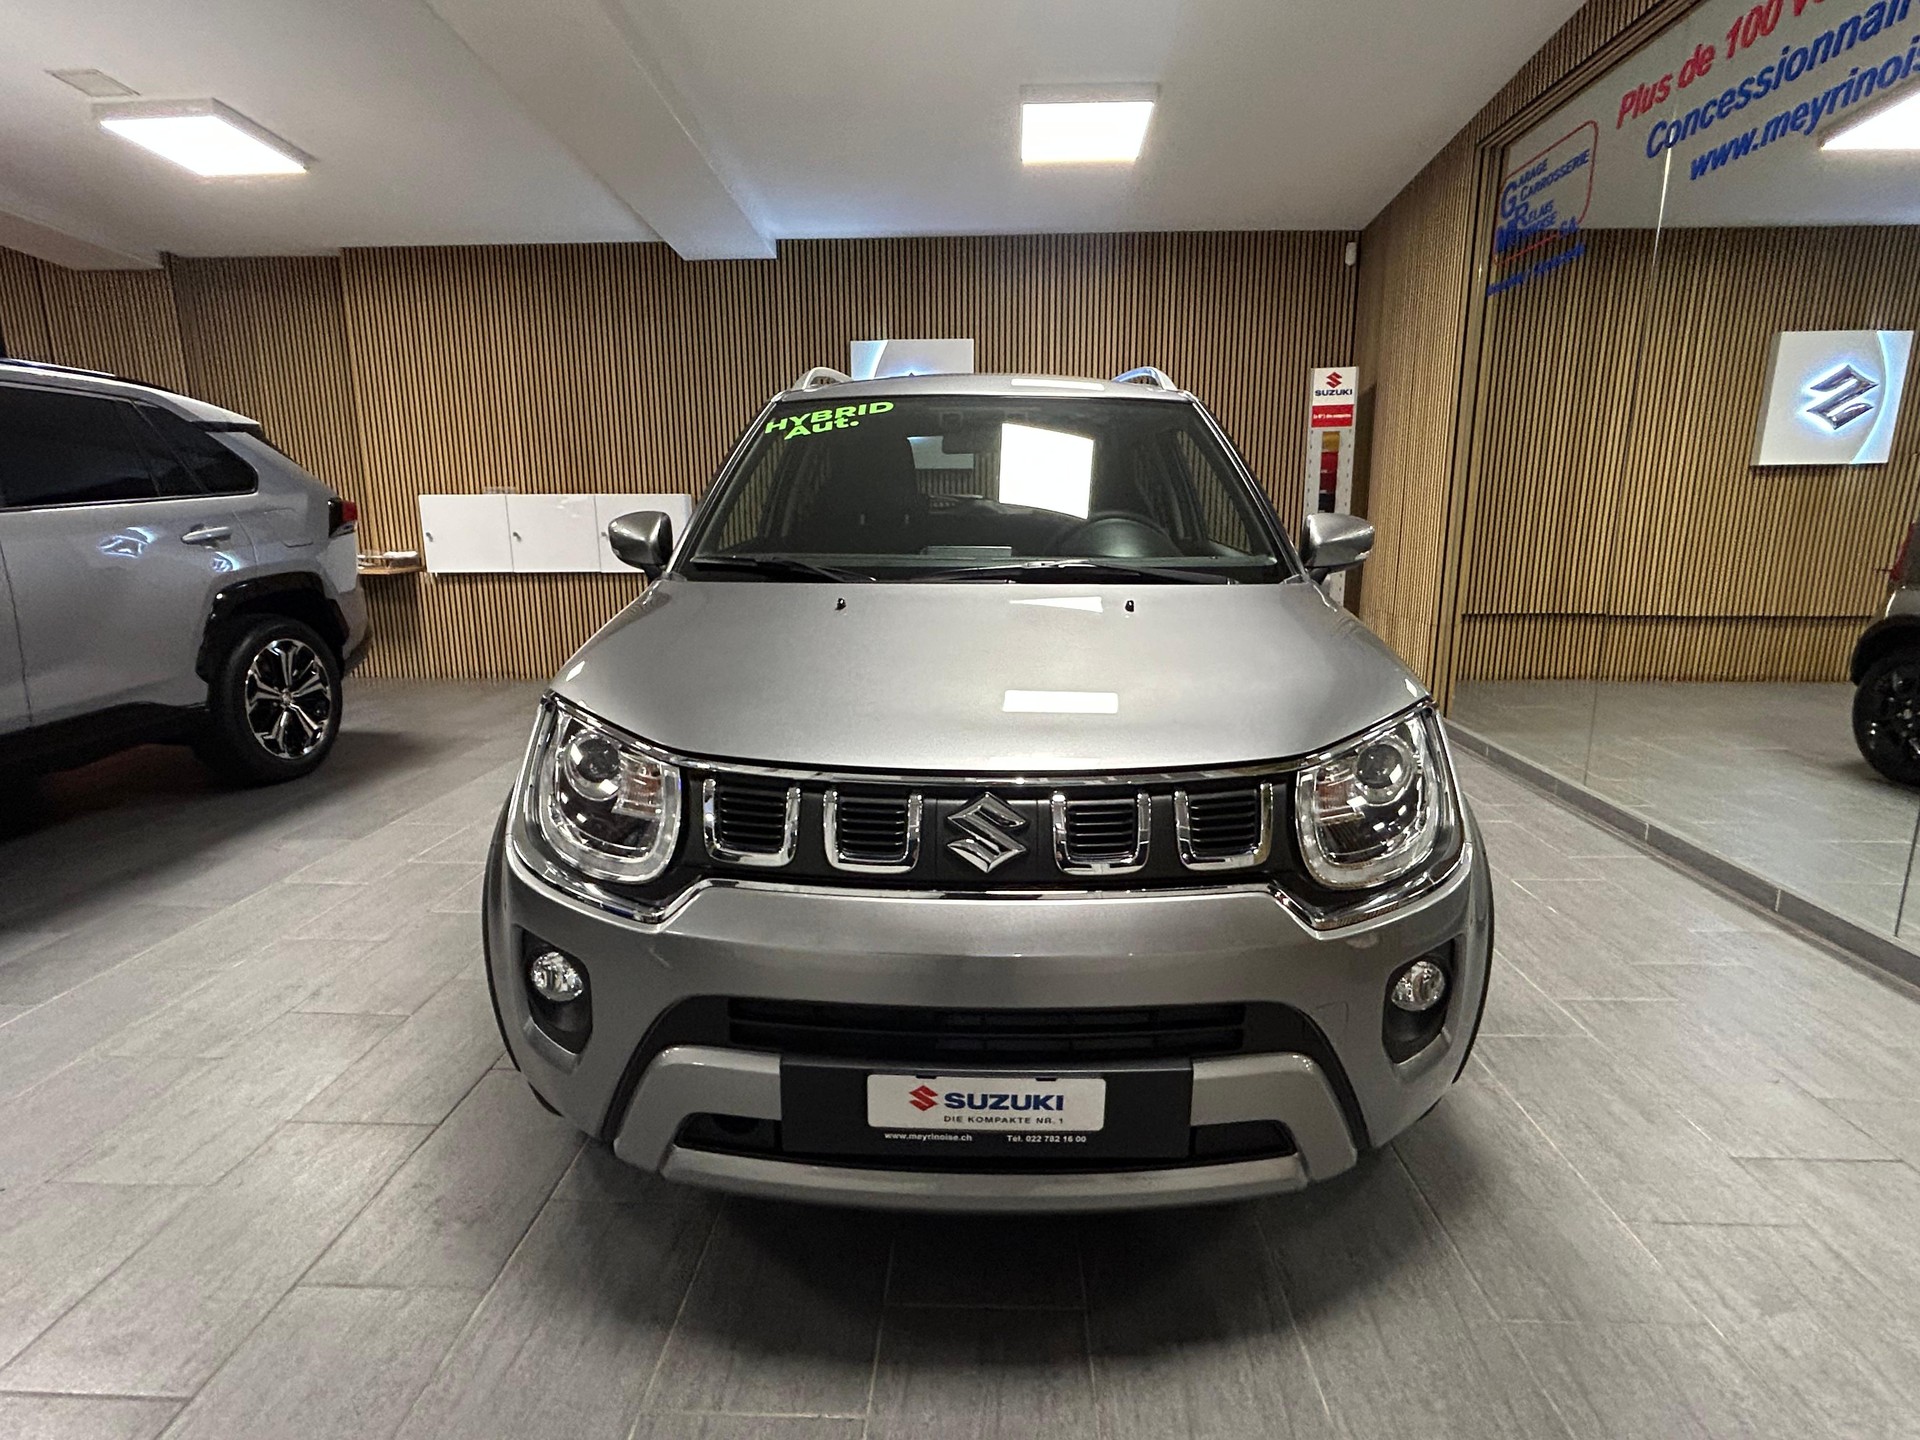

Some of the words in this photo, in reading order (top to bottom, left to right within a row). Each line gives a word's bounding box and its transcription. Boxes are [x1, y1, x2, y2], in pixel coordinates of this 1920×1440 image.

[1616, 73, 1673, 130] Plus
[1678, 43, 1716, 89] de
[1726, 0, 1784, 60] 100
[1314, 388, 1353, 397] SUZUKI
[764, 401, 895, 434] HYBRID
[784, 417, 860, 441] Aut.
[943, 1092, 1065, 1112] SUZUKI
[943, 1115, 963, 1124] DIE
[967, 1116, 1031, 1125] KOMPAKTE
[1058, 1117, 1064, 1125] 1
[883, 1131, 973, 1142] www.meyrinoise.ch
[1025, 1135, 1042, 1143] 022
[1044, 1135, 1061, 1143] 782
[1062, 1135, 1074, 1143] 16
[1075, 1135, 1087, 1143] 00
